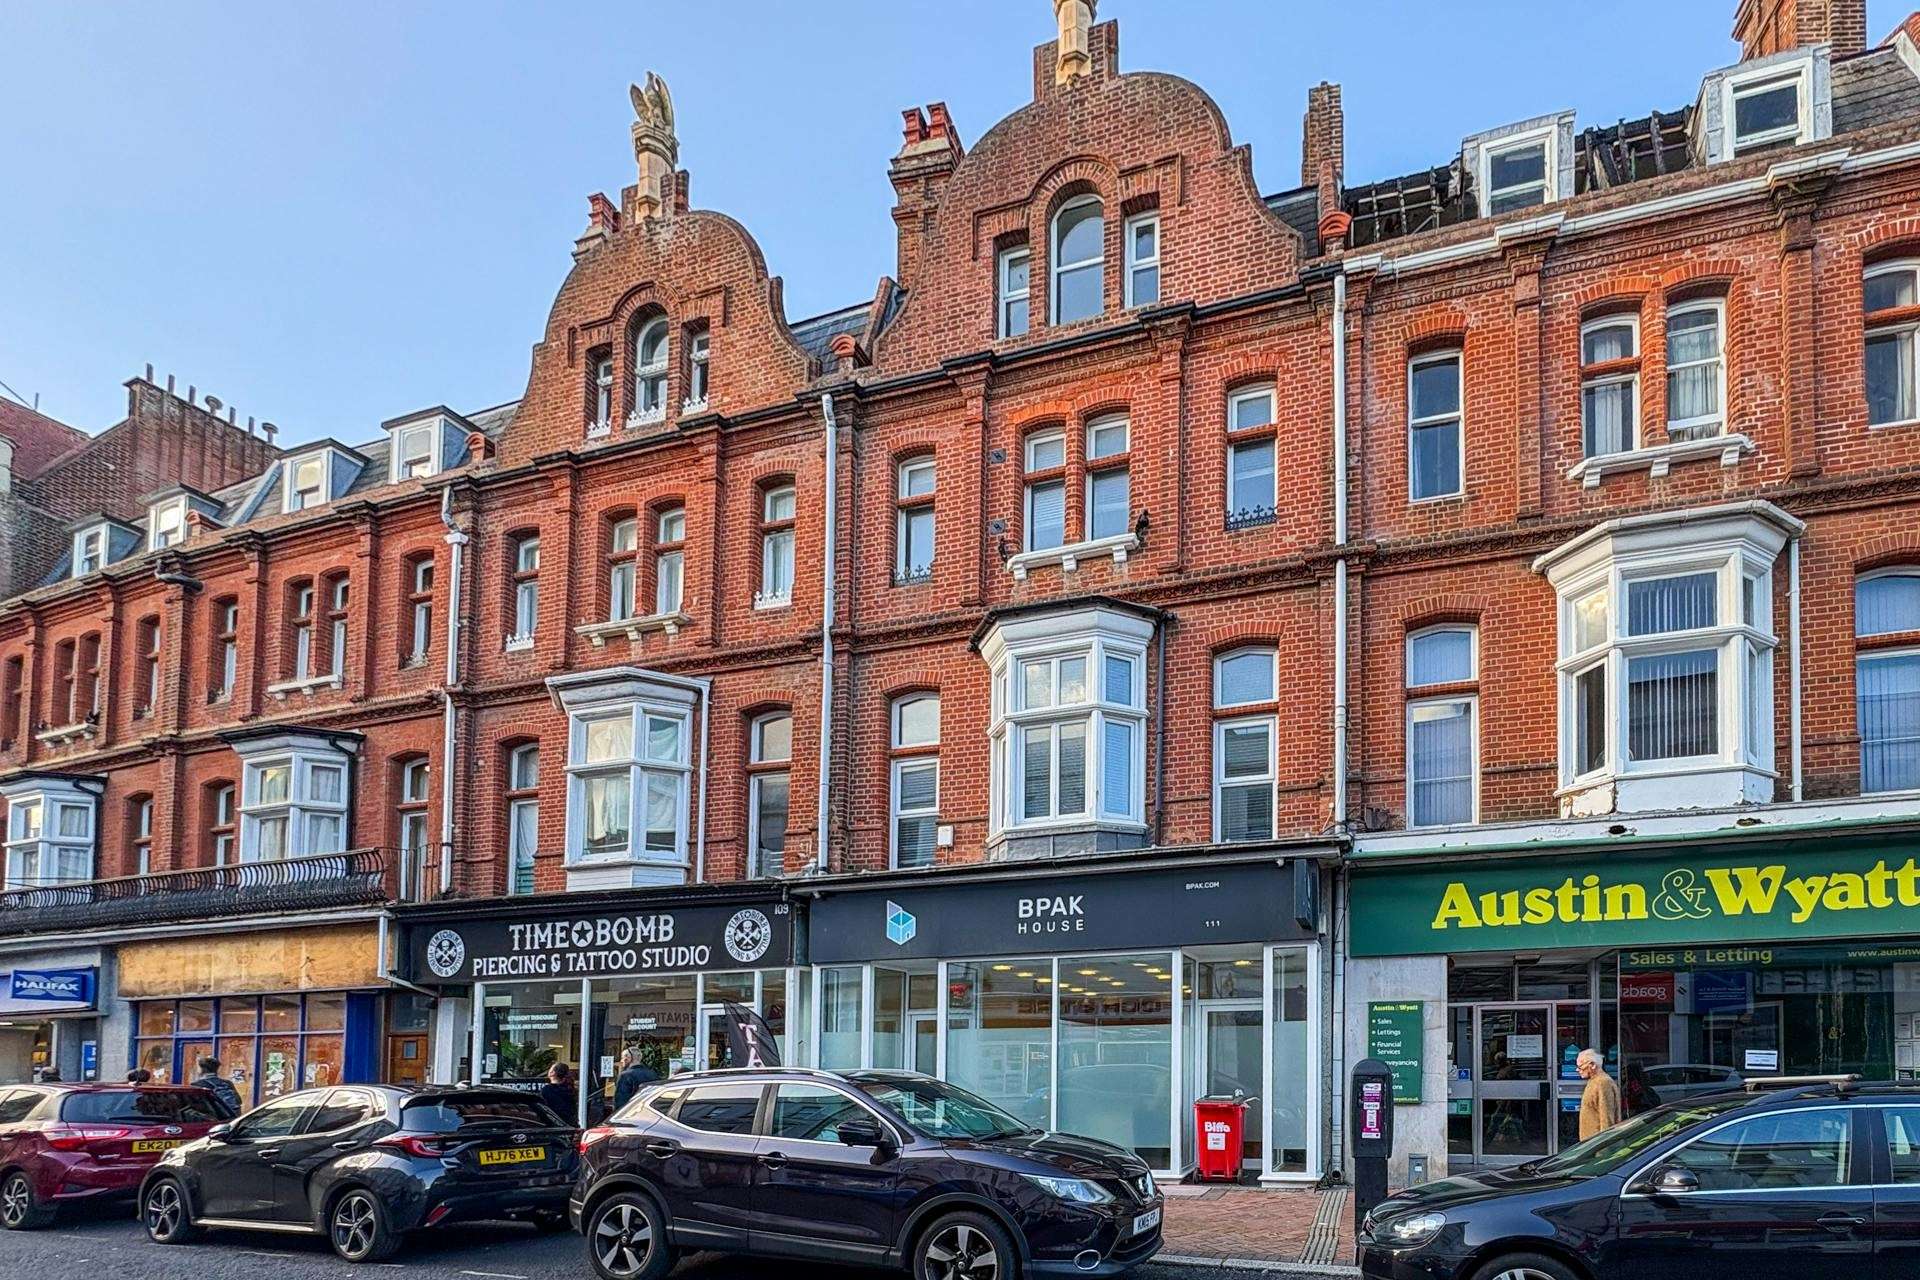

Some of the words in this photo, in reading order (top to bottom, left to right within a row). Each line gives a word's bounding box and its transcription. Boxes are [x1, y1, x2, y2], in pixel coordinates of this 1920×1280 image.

[1185, 881, 1220, 890] BPAK.COM
[1432, 874, 1648, 930] Austin
[1652, 868, 1712, 921] &
[1704, 858, 1920, 924] Wyatt
[774, 903, 789, 915] 109
[1018, 895, 1084, 919] BPAK
[1017, 919, 1084, 934] HOUSE
[1205, 920, 1220, 928] 111
[472, 954, 547, 977] PIERCING
[550, 952, 561, 973] &
[565, 949, 637, 972] TATTOO
[641, 945, 710, 969] STUDIO
[1629, 951, 1675, 965] Sales
[1683, 950, 1697, 963] &
[1706, 947, 1773, 965] Letting
[14, 980, 80, 991] HALIFAX
[1399, 1003, 1418, 1011] Wyatt
[1204, 1121, 1231, 1132] Biffa
[138, 1141, 172, 1151] EK20
